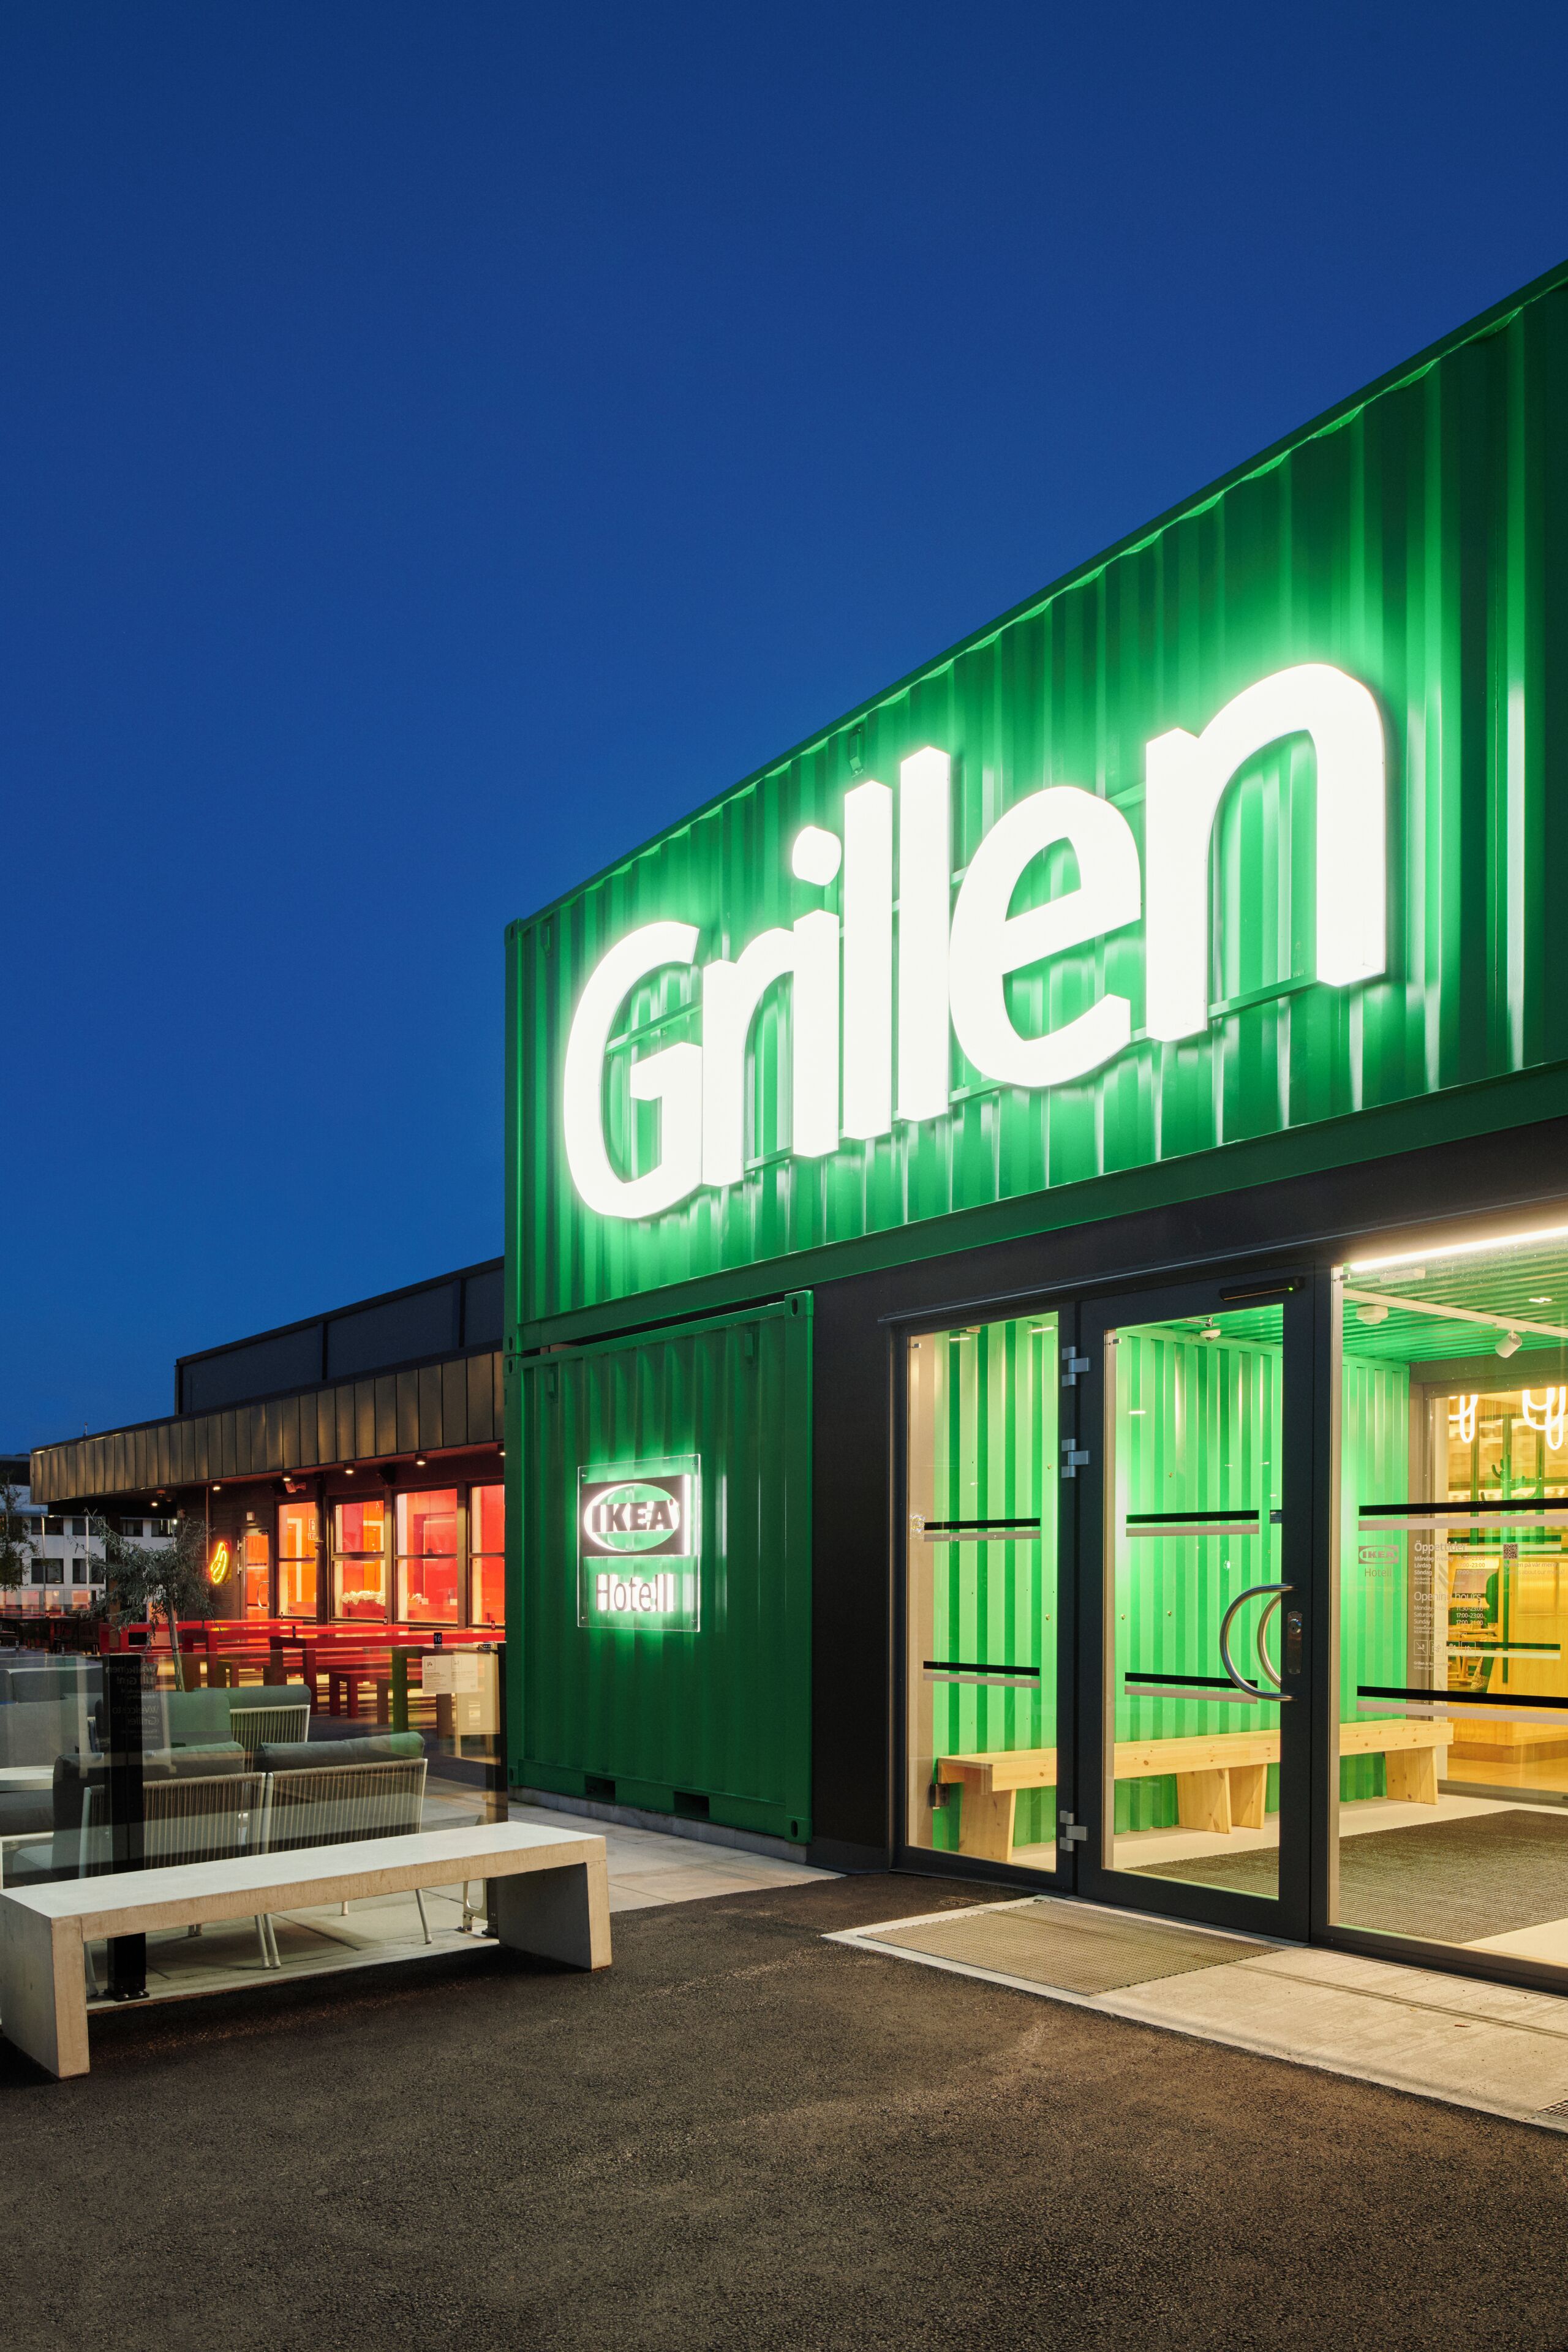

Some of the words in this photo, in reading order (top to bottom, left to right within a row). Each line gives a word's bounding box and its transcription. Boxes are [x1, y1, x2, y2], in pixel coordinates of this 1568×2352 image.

[564, 663, 1386, 1219] Grillen
[592, 1499, 674, 1533] IKEA
[1414, 1540, 1466, 1555] Öppettider
[1365, 1567, 1392, 1577] Hotell
[596, 1574, 673, 1612] Hotell
[1414, 1591, 1452, 1604] Opening
[1455, 1591, 1482, 1601] hours
